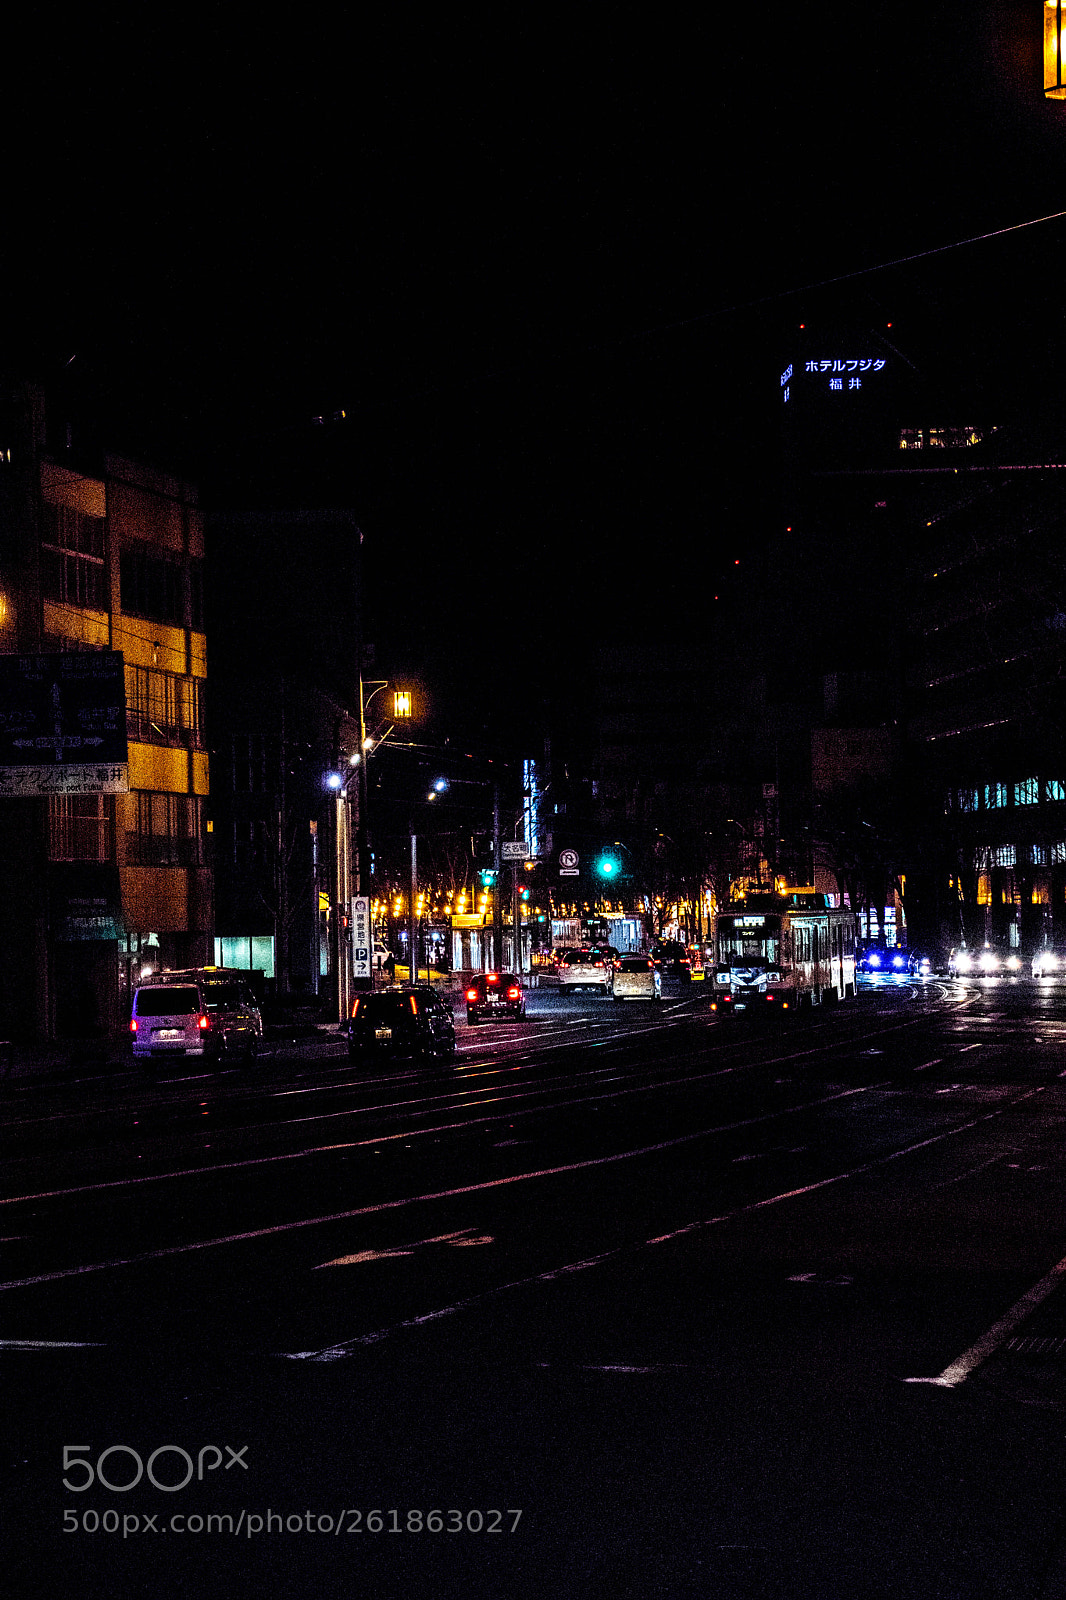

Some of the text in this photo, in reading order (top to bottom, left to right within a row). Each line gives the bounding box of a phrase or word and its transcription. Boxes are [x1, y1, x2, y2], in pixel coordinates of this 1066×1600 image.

[805, 358, 886, 372] ホテルフジタ
[829, 377, 862, 390] 福井
